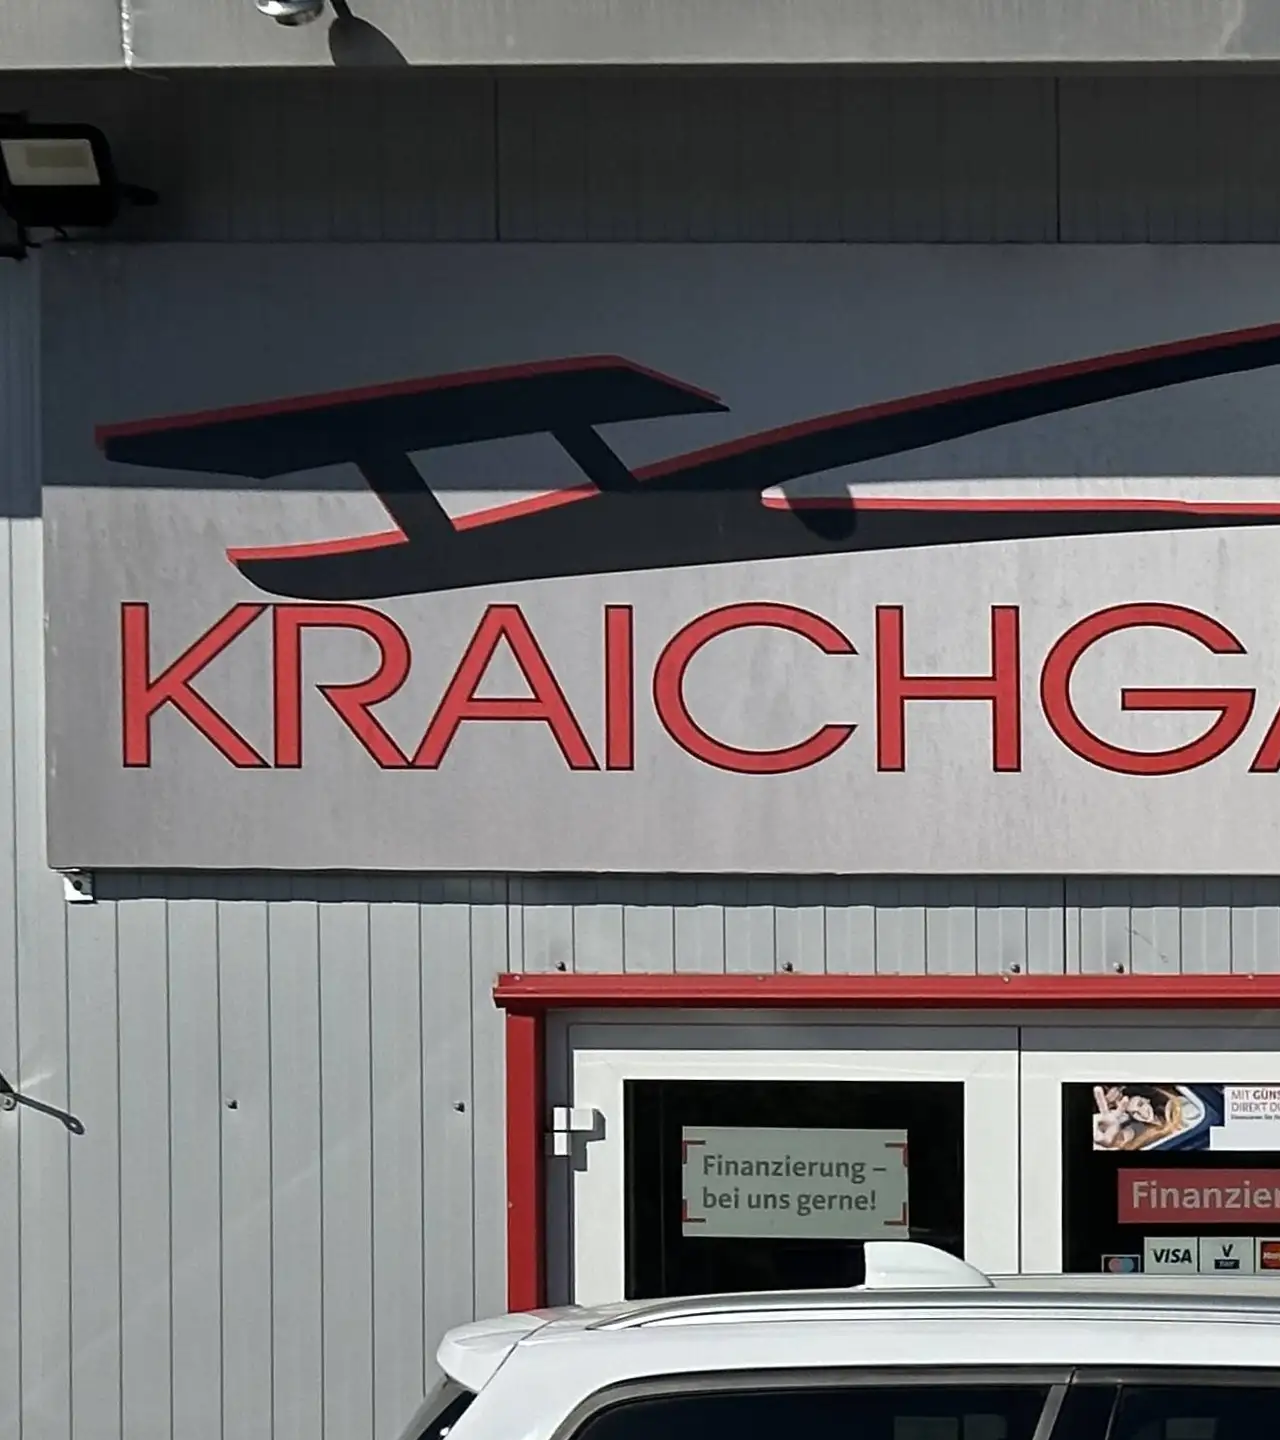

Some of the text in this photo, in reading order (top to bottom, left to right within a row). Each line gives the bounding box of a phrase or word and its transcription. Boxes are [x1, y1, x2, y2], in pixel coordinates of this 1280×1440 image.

[1231, 1090, 1250, 1101] MIT
[1231, 1101, 1268, 1113] DIREKT
[702, 1154, 866, 1184] Finanzierung
[702, 1186, 877, 1217] bei uns gerne!
[1153, 1248, 1193, 1264] VISA
